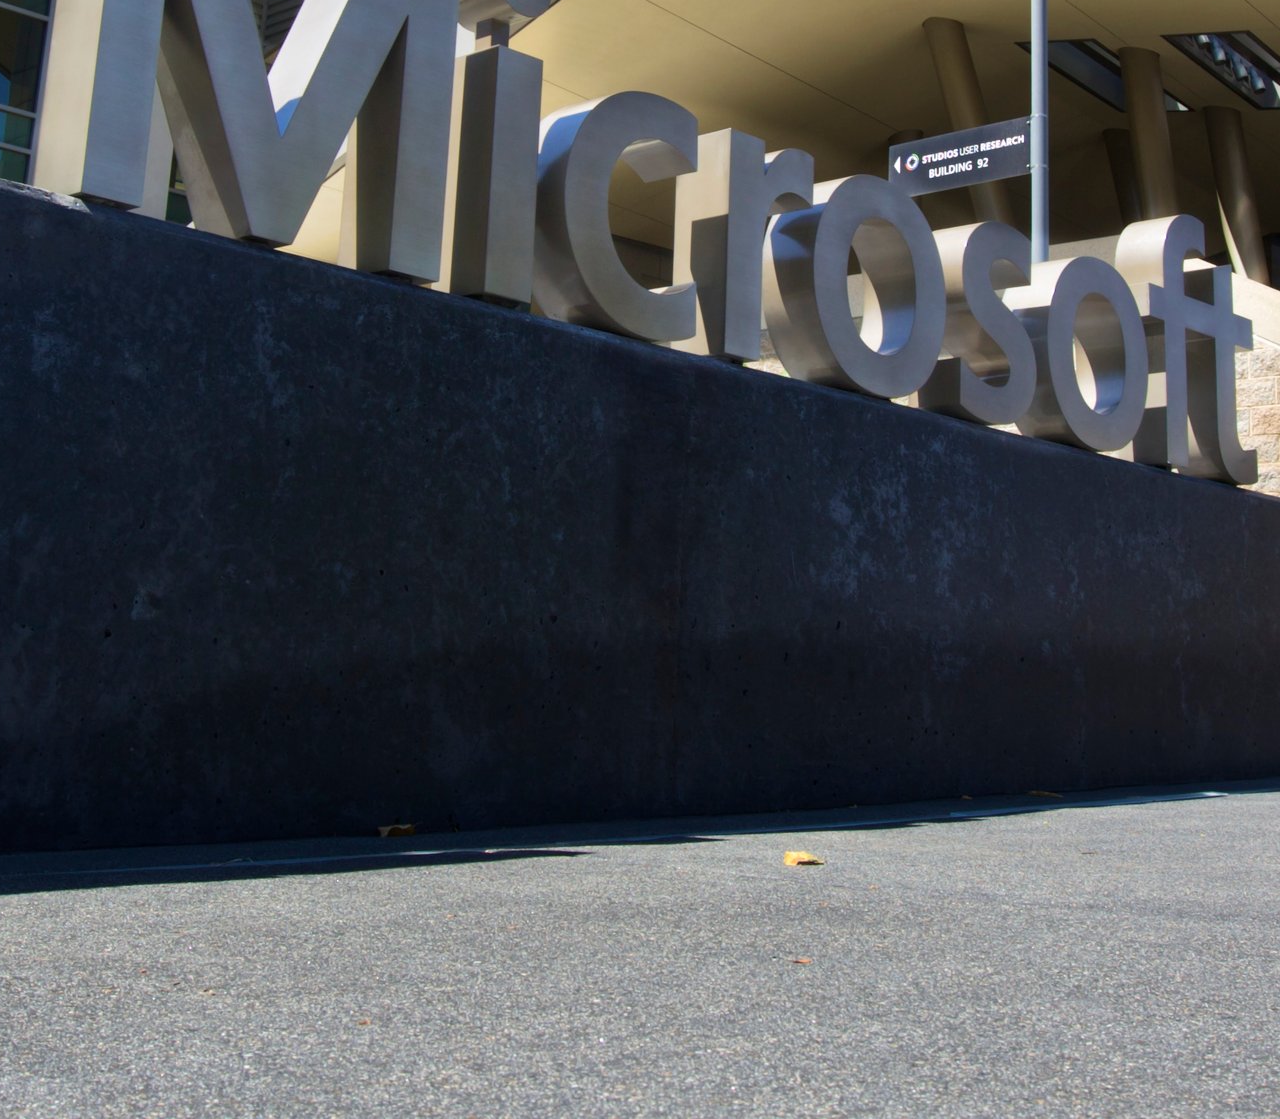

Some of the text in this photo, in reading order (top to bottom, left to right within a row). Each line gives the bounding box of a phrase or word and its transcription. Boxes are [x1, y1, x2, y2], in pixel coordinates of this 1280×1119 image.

[922, 134, 1025, 164] STUDIOS USER RESEARCH
[928, 157, 989, 179] BUILDING 92
